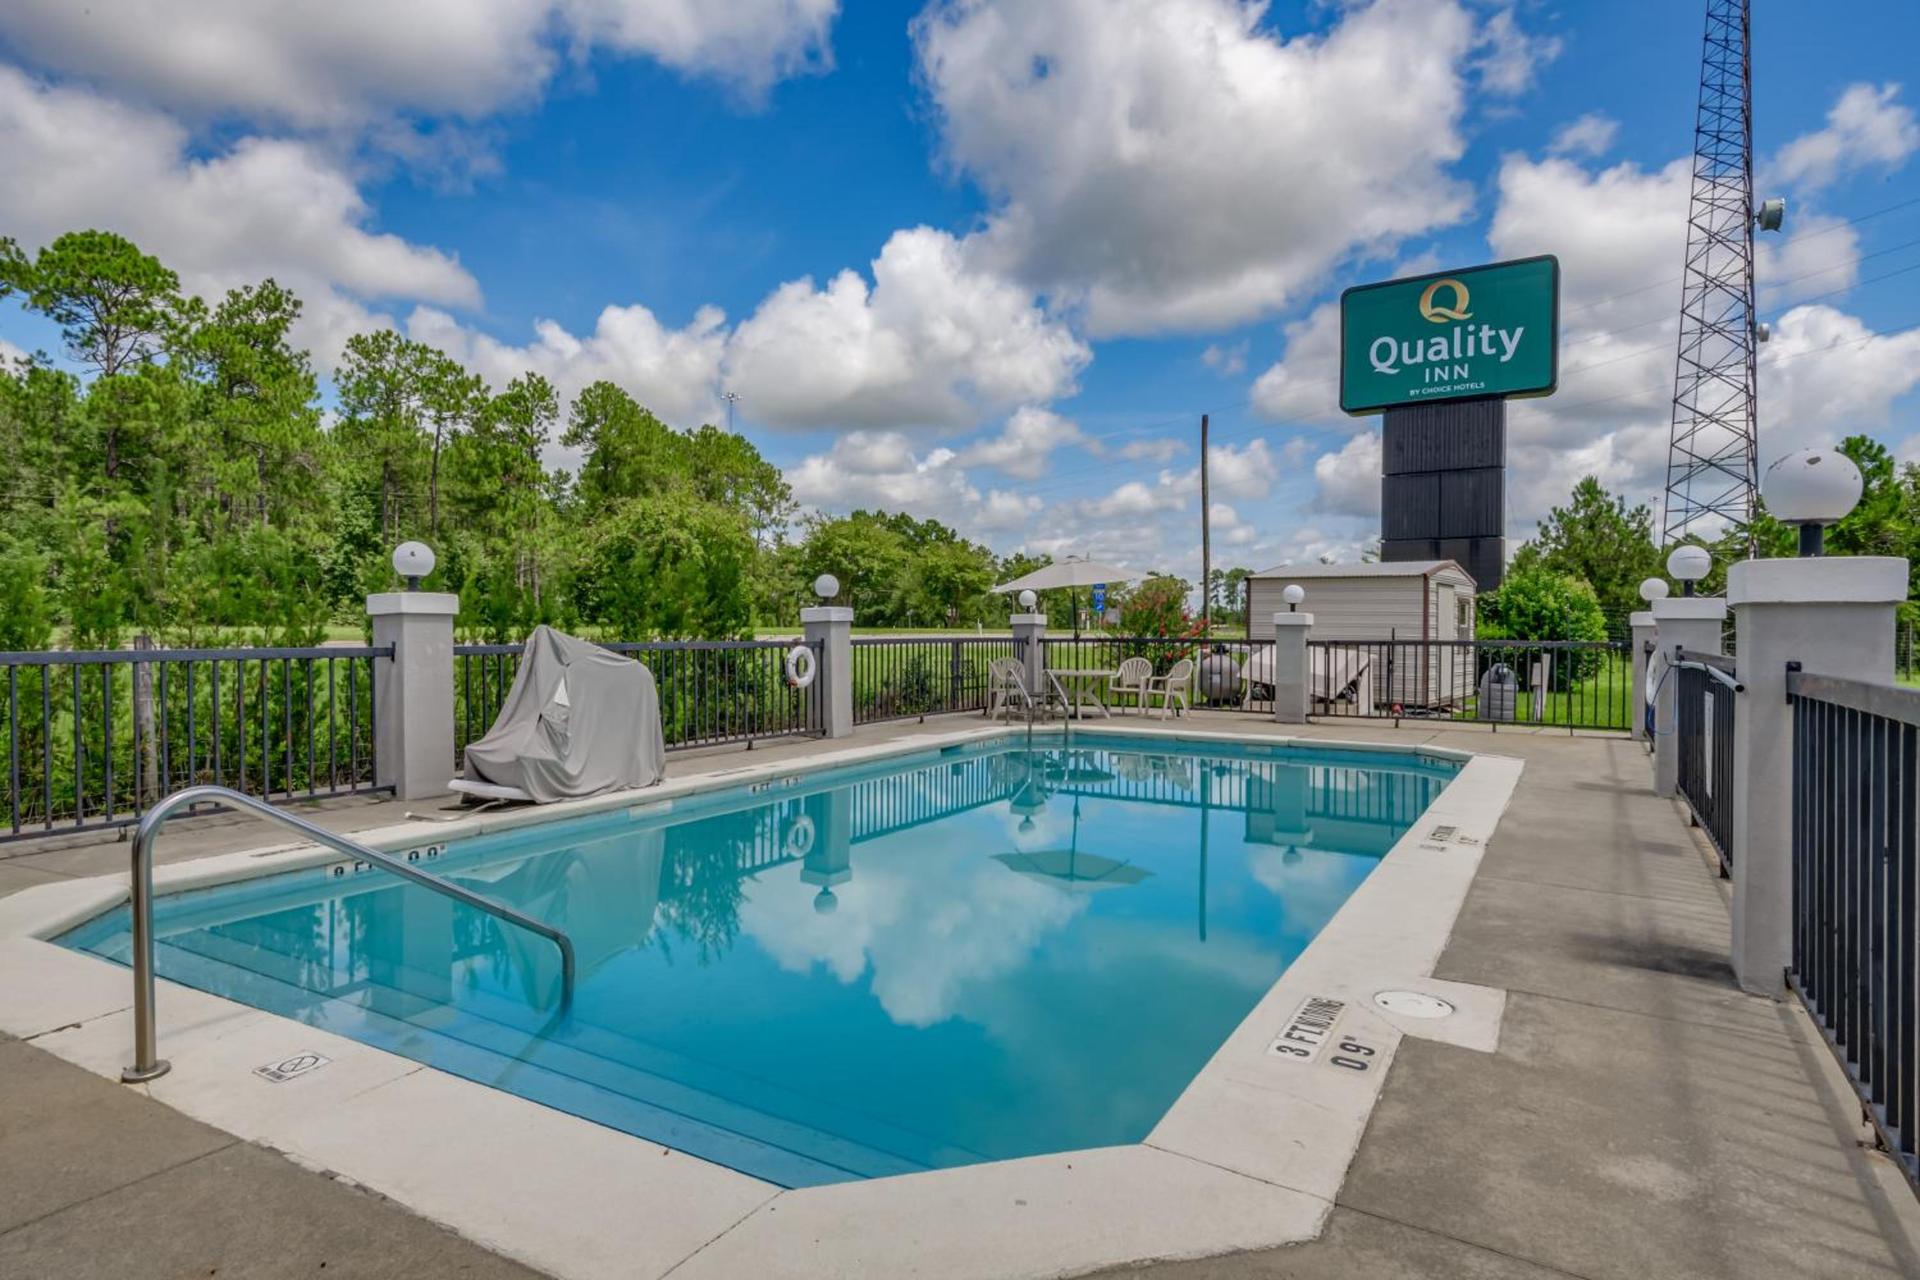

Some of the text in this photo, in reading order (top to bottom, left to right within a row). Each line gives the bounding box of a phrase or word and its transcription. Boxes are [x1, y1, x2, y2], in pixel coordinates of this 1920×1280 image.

[1369, 324, 1525, 374] Quality
[1425, 363, 1470, 383] INN
[1421, 385, 1452, 394] CHOICE
[1453, 381, 1485, 392] HOTELS
[1284, 1025, 1324, 1044] FT
[1275, 1045, 1310, 1057] 3
